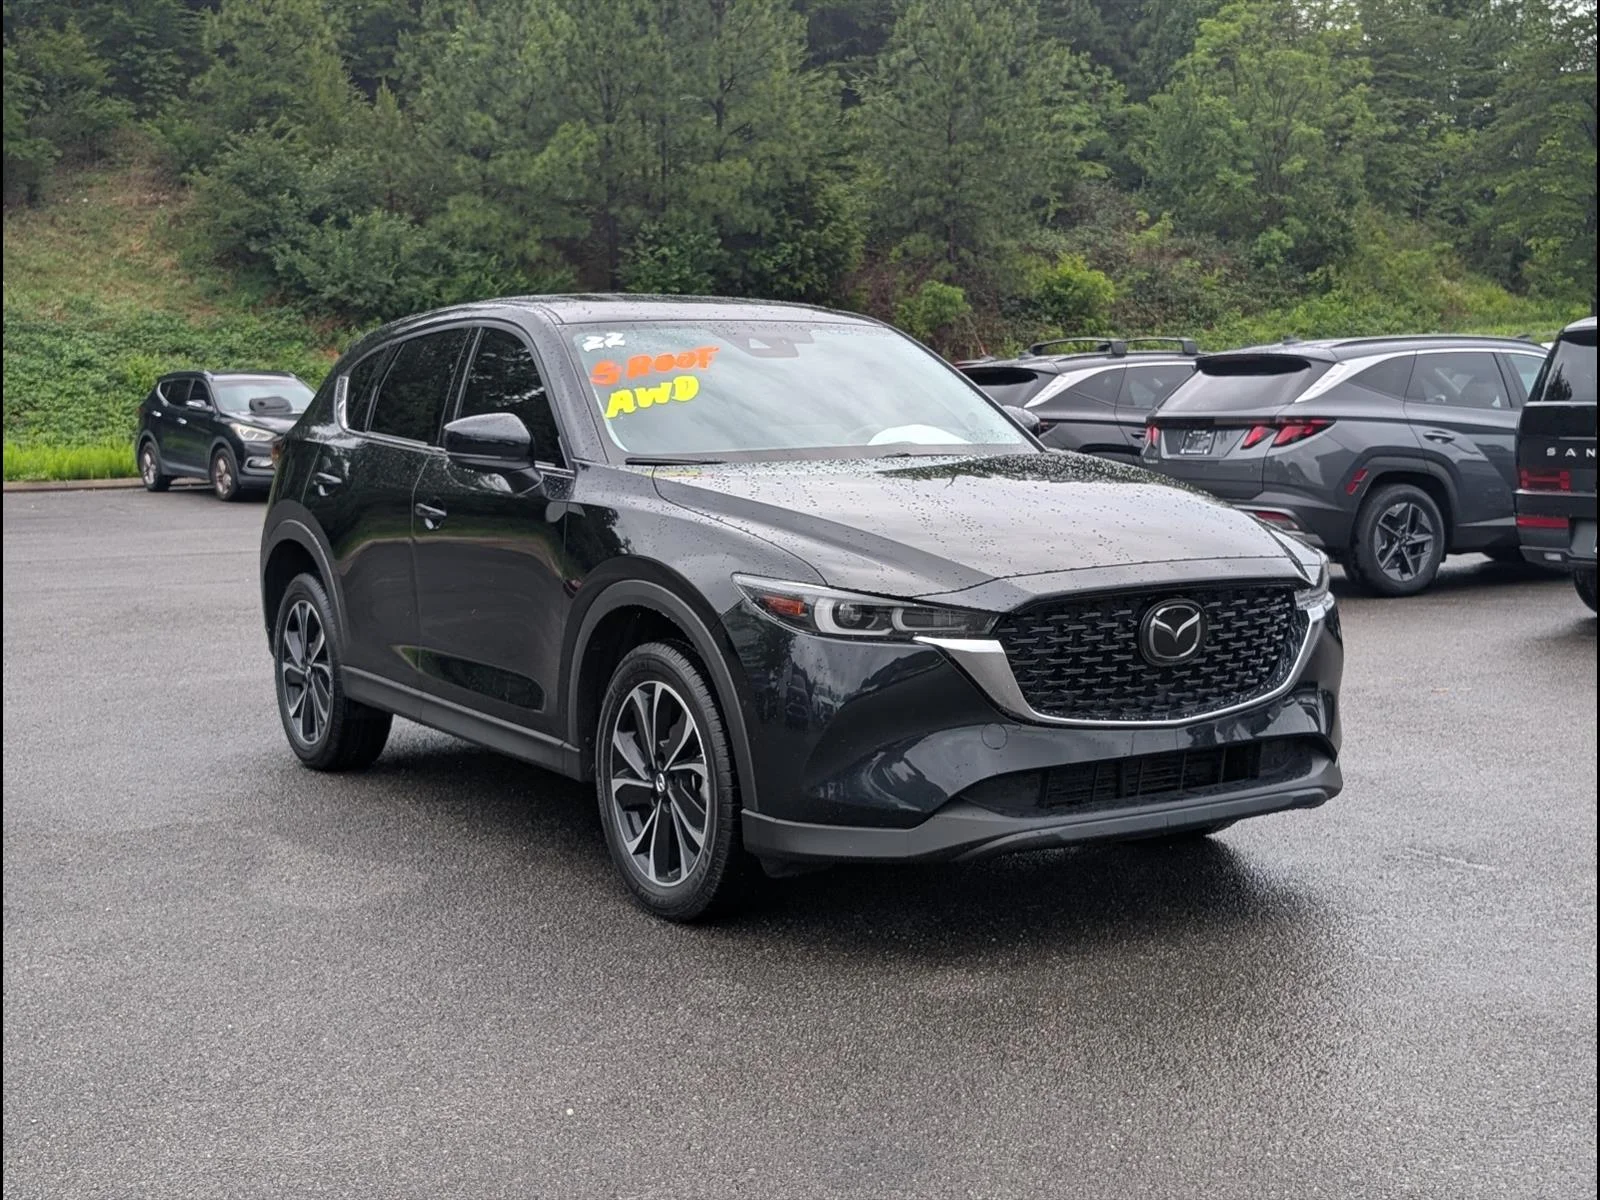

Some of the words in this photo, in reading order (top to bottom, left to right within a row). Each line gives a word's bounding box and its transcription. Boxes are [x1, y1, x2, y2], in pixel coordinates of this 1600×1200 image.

[582, 332, 625, 352] 22
[627, 346, 720, 379] ROOF
[604, 375, 699, 418] AWD
